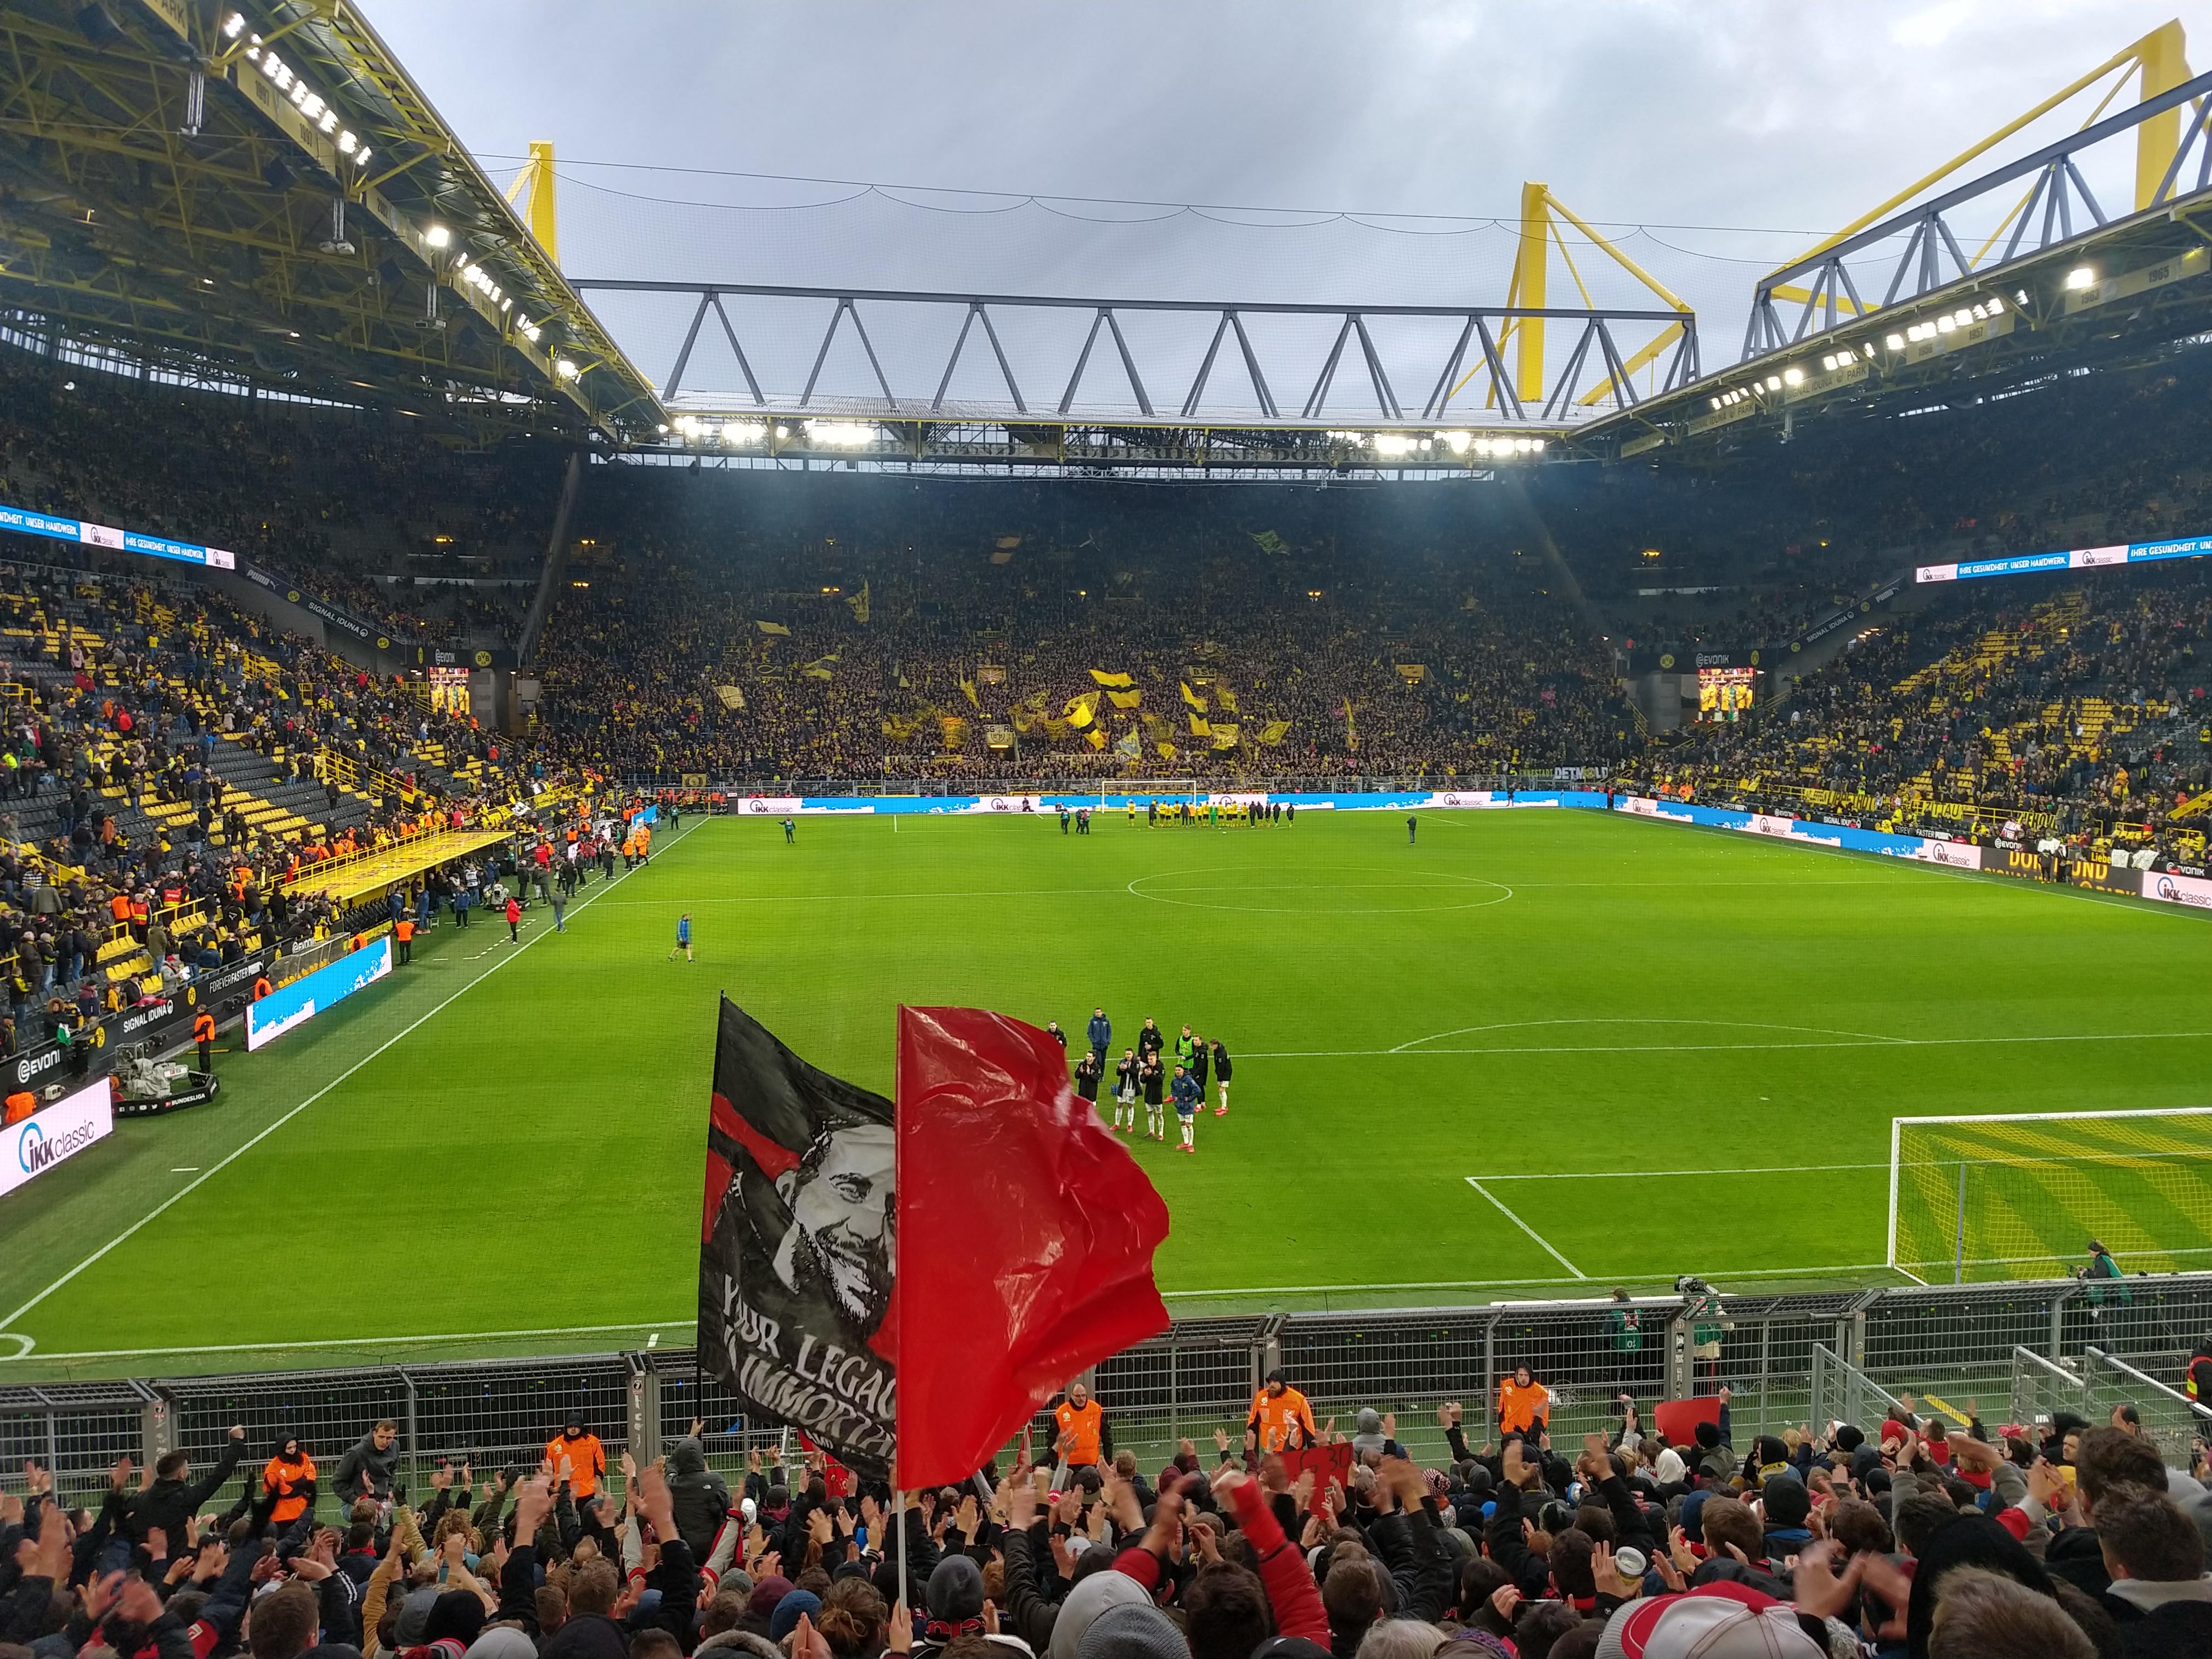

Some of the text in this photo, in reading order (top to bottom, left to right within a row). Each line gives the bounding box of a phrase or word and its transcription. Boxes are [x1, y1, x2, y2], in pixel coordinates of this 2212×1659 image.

[155, 0, 185, 28] ARK
[2148, 266, 2169, 283] 1965
[1847, 365, 1866, 380] PARK
[1737, 404, 1754, 416] PARK
[25, 517, 45, 529] UNSER
[2131, 548, 2147, 557] IHRE
[1959, 566, 1971, 574] IHRE
[2010, 560, 2030, 569] UNSER
[247, 569, 270, 586] PUMA
[308, 602, 359, 635] SIGNAL IDUNA
[1807, 616, 1849, 642] SIGNAL IDUNA
[1704, 654, 1729, 664] EVONIK
[1824, 816, 1841, 825] SIGNAL
[1916, 828, 1935, 838] FASTER
[2002, 840, 2022, 850] EVONI
[1949, 854, 1970, 866] classic
[2091, 851, 2112, 865] Liebe
[2176, 865, 2205, 877] VONIK
[2180, 891, 2211, 906] classic
[123, 1004, 167, 1034] SIGNAL IDUNA
[31, 1048, 61, 1075] EVONI
[172, 1093, 206, 1106] BUNDESLIGA
[55, 1119, 95, 1158] classic
[1327, 1444, 1351, 1471] 30
